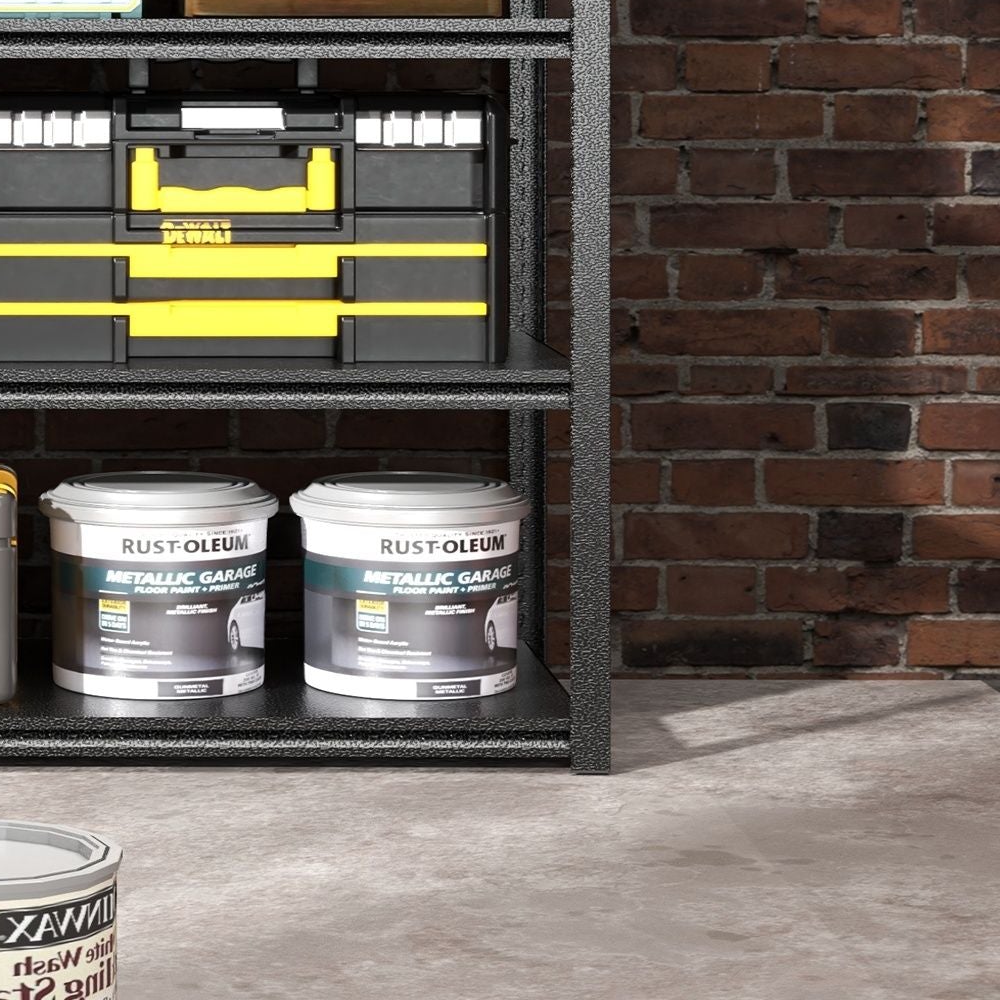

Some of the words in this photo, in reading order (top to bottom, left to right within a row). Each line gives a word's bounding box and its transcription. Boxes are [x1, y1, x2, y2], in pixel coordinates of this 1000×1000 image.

[122, 534, 249, 554] RUST-OLEUM
[381, 534, 506, 555] RUST-OLEUM
[105, 569, 195, 585] METALLIC
[199, 563, 257, 584] GARAGE
[363, 570, 455, 586] METALLIC
[457, 564, 512, 584] GARAGE
[134, 585, 168, 594] FLOOR
[170, 586, 201, 594] PAINT
[209, 582, 240, 592] PRIMER
[392, 586, 426, 594] FLOOR
[428, 586, 460, 594] PAINT
[467, 582, 497, 592] PRIMER
